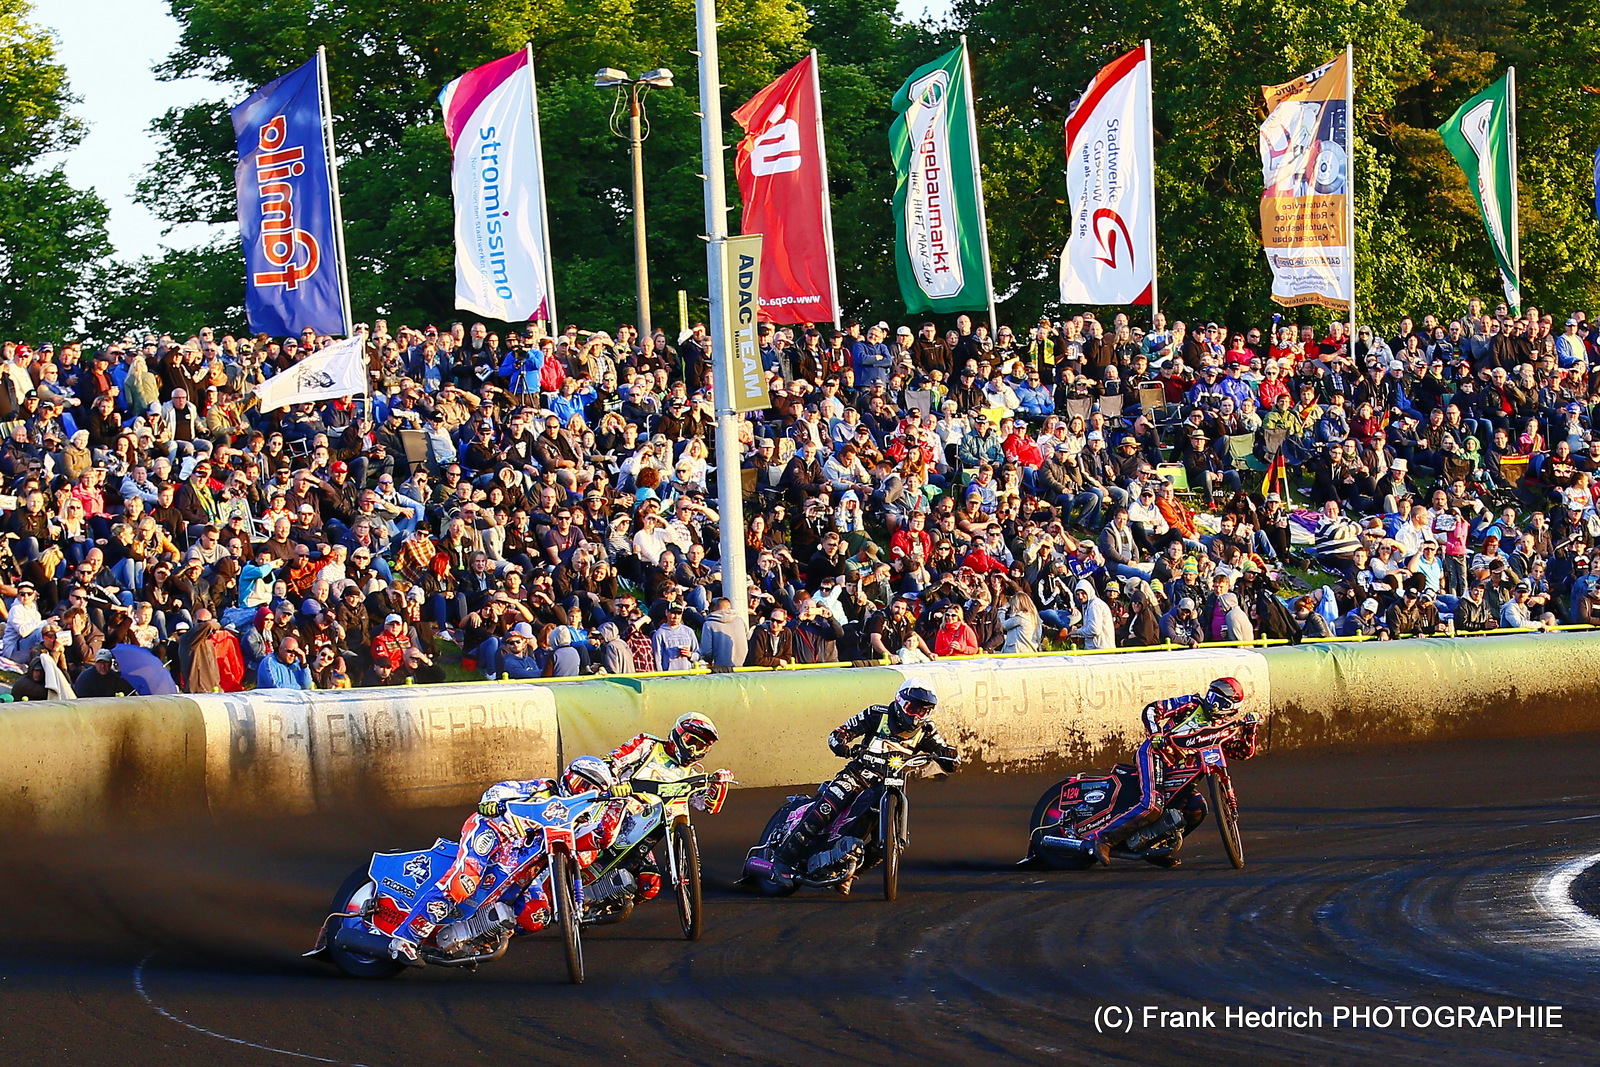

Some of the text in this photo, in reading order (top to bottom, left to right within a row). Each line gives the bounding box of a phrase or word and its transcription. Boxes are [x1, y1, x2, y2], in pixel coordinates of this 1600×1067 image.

[1106, 118, 1121, 203] Stadtwerke
[479, 126, 513, 300] stromissimo
[1079, 223, 1087, 239] Sie.
[1080, 209, 1088, 222] für
[474, 221, 486, 269] Stadtwerken
[917, 233, 930, 259] MAN
